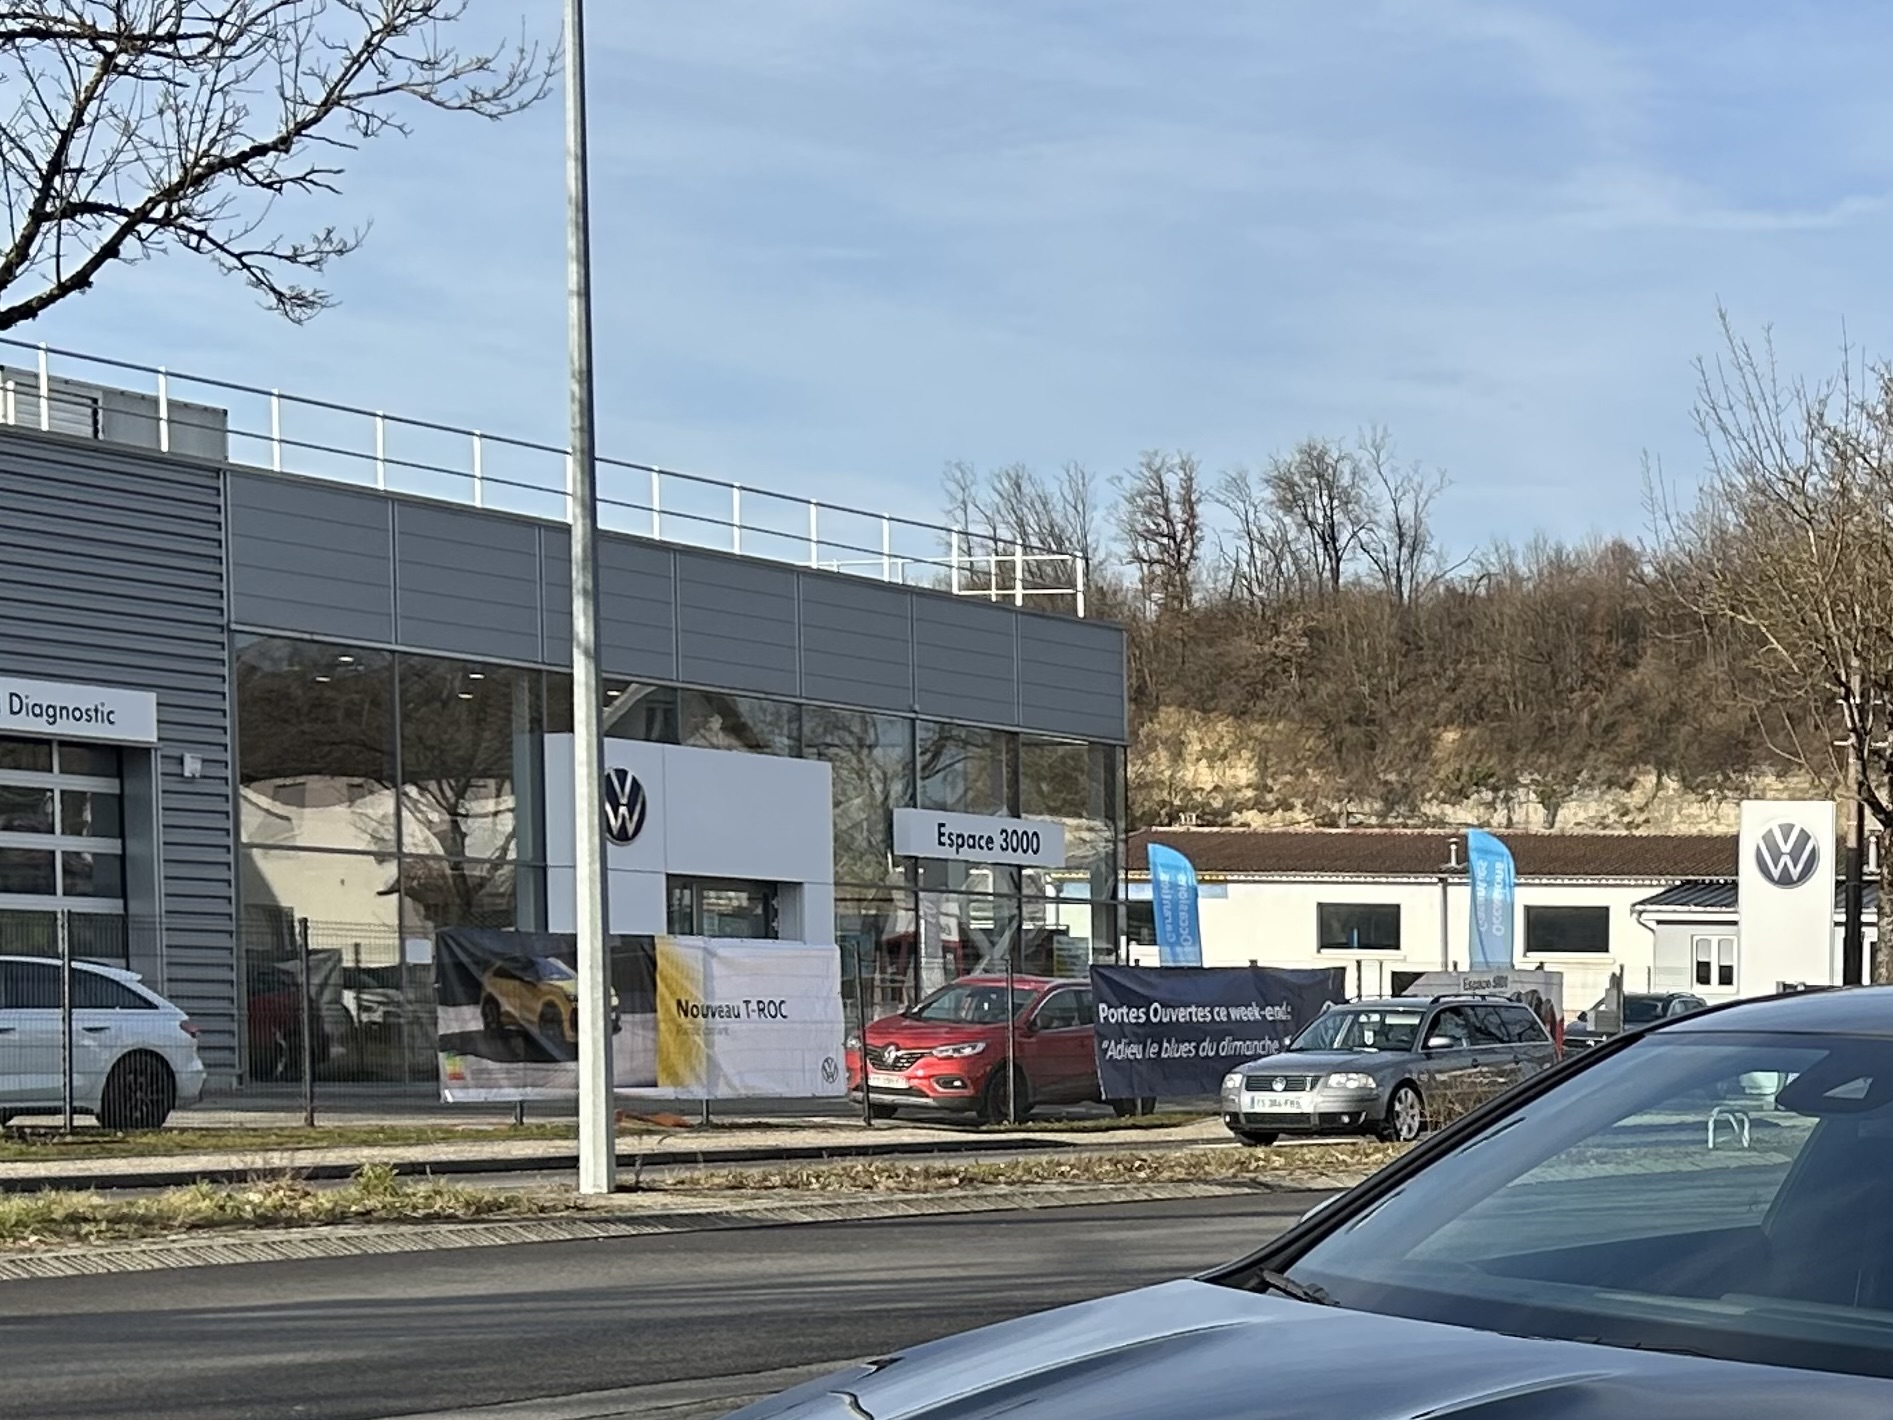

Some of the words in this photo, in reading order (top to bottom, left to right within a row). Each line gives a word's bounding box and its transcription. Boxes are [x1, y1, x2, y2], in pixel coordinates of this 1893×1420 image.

[9, 692, 116, 725] Diagnostic
[937, 822, 995, 855] Espace
[1000, 828, 1040, 855] 3000
[676, 999, 741, 1019] Nouveau
[743, 1000, 788, 1019] T-ROC
[1099, 1003, 1146, 1023] Portes
[1150, 1002, 1211, 1023] Ouvertes
[1214, 1007, 1227, 1022] ce
[1145, 1038, 1158, 1058] le
[1161, 1036, 1196, 1058] blues
[1200, 1037, 1216, 1057] du
